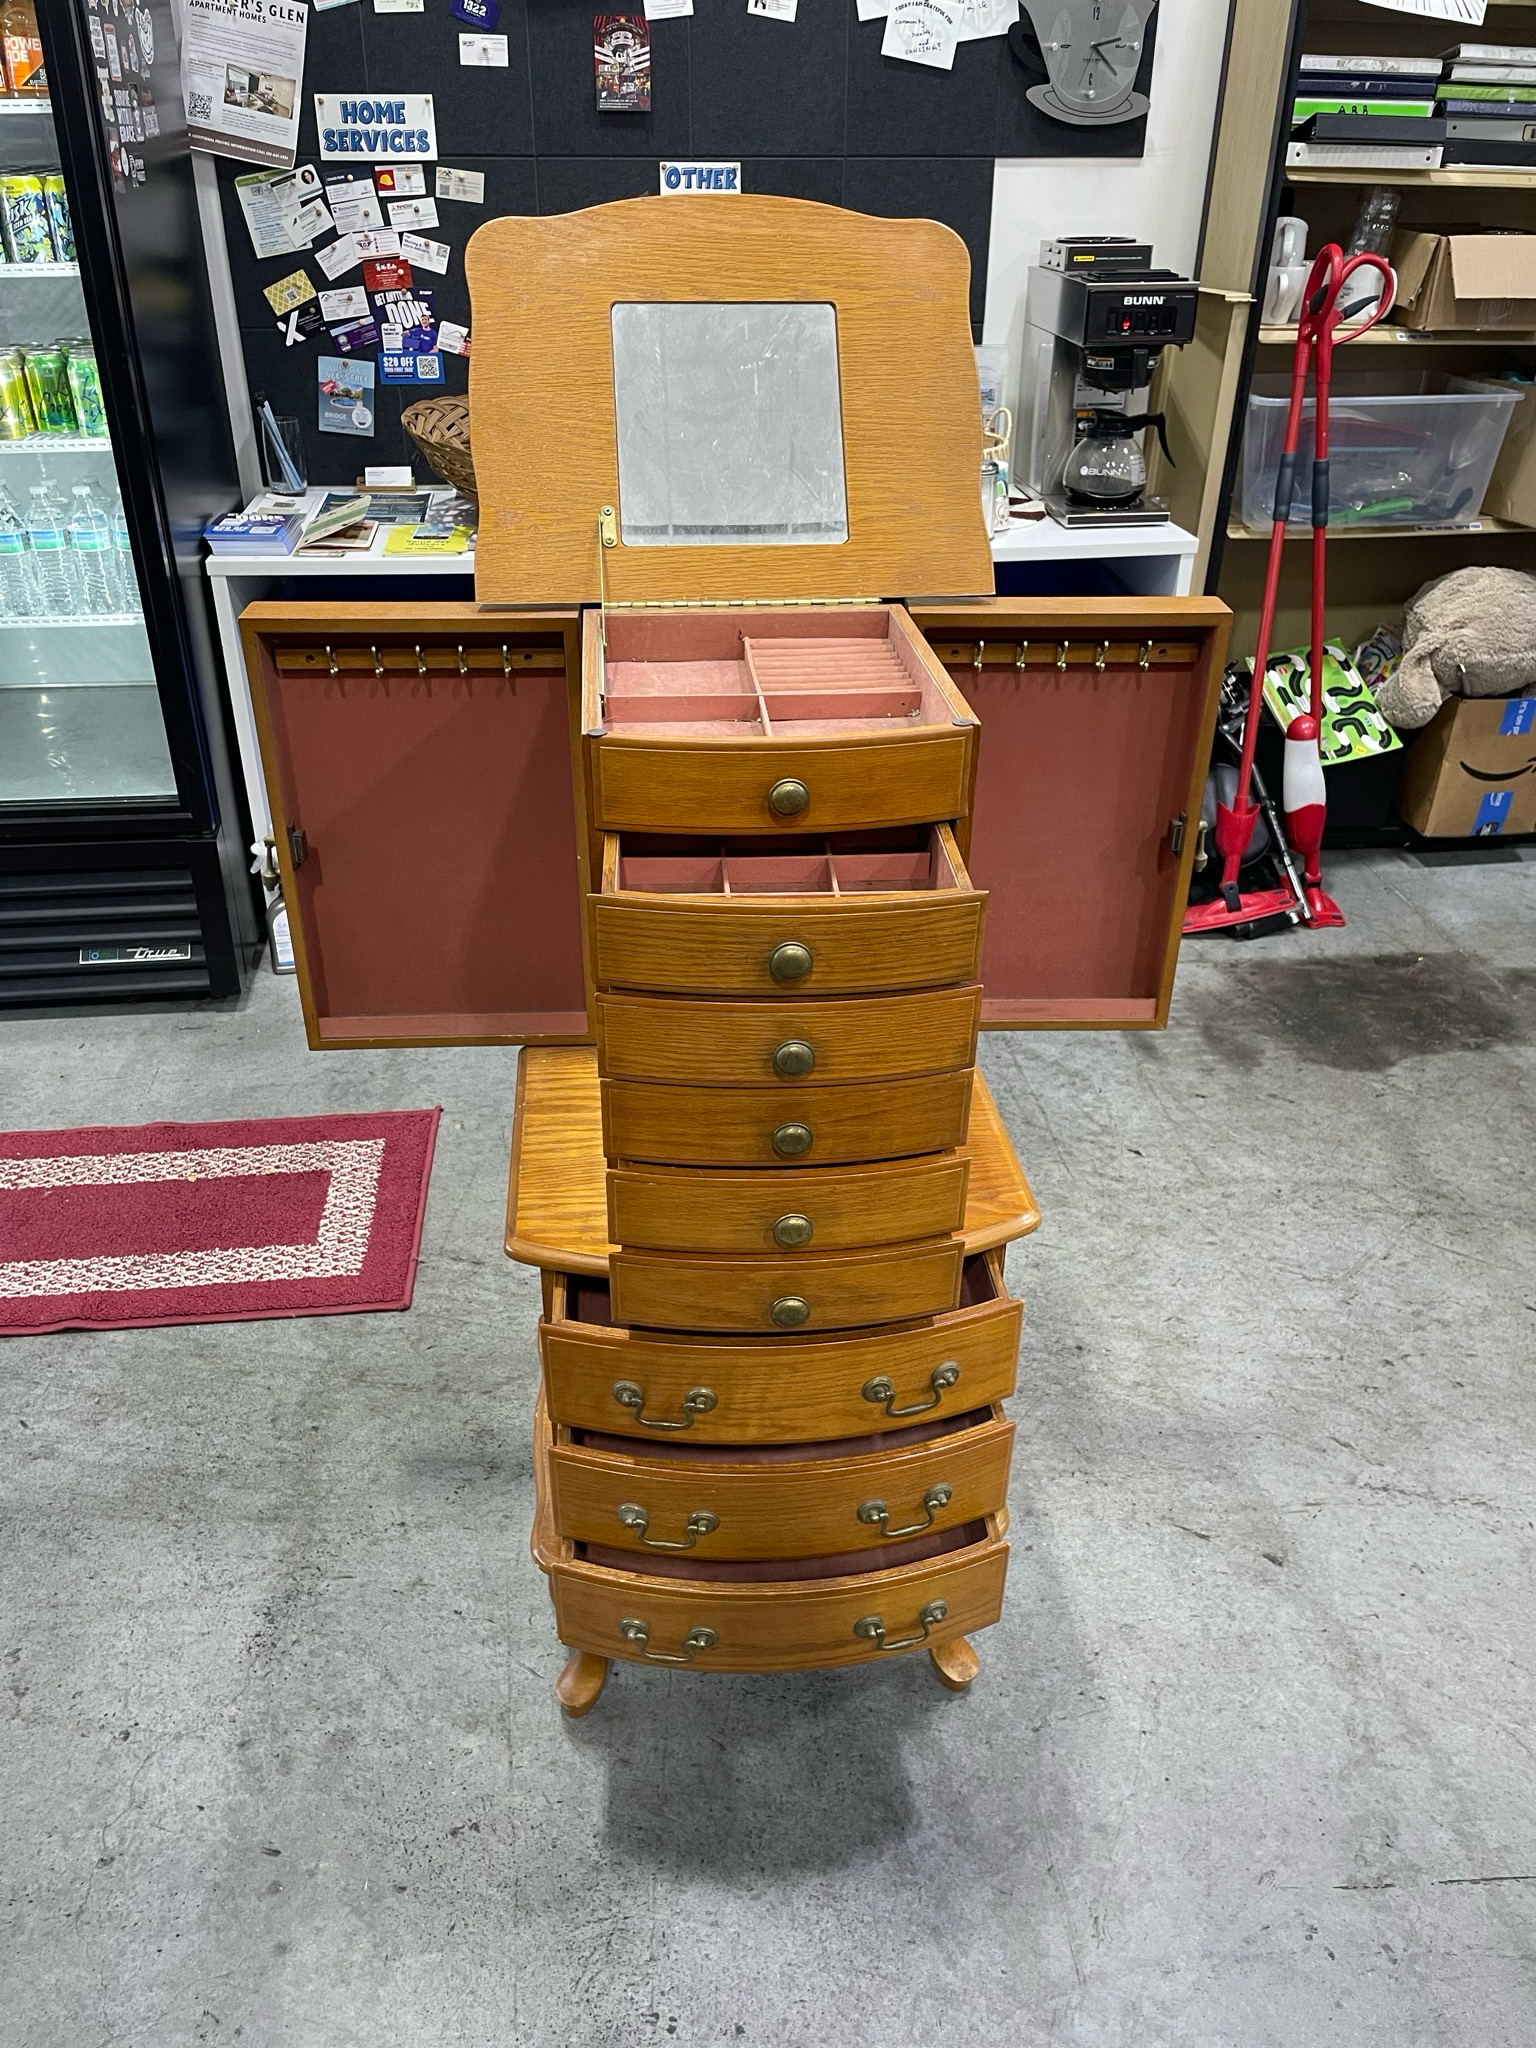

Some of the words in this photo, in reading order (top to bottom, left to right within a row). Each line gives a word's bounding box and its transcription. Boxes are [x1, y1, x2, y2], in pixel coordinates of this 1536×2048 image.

[189, 0, 237, 16] APARTMENT
[239, 10, 267, 23] HOMES
[269, 5, 304, 23] GLEN
[463, 0, 487, 17] 1322
[895, 1, 911, 12] TODAY
[923, 2, 946, 17] GRATEFUL
[944, 15, 953, 25] FOR
[1092, 6, 1101, 20] 12
[4, 36, 41, 51] POWE
[340, 100, 406, 124] HOME
[323, 128, 431, 153] SERVICES
[665, 166, 737, 190] OTHER
[1124, 296, 1164, 305] BUNN
[385, 300, 436, 329] DONE
[383, 356, 399, 367] $20
[400, 356, 414, 367] OFF
[325, 371, 350, 380] WEEKS
[350, 374, 368, 383] FREE
[324, 411, 347, 420] BRIDGE
[1087, 467, 1121, 476] BUNN
